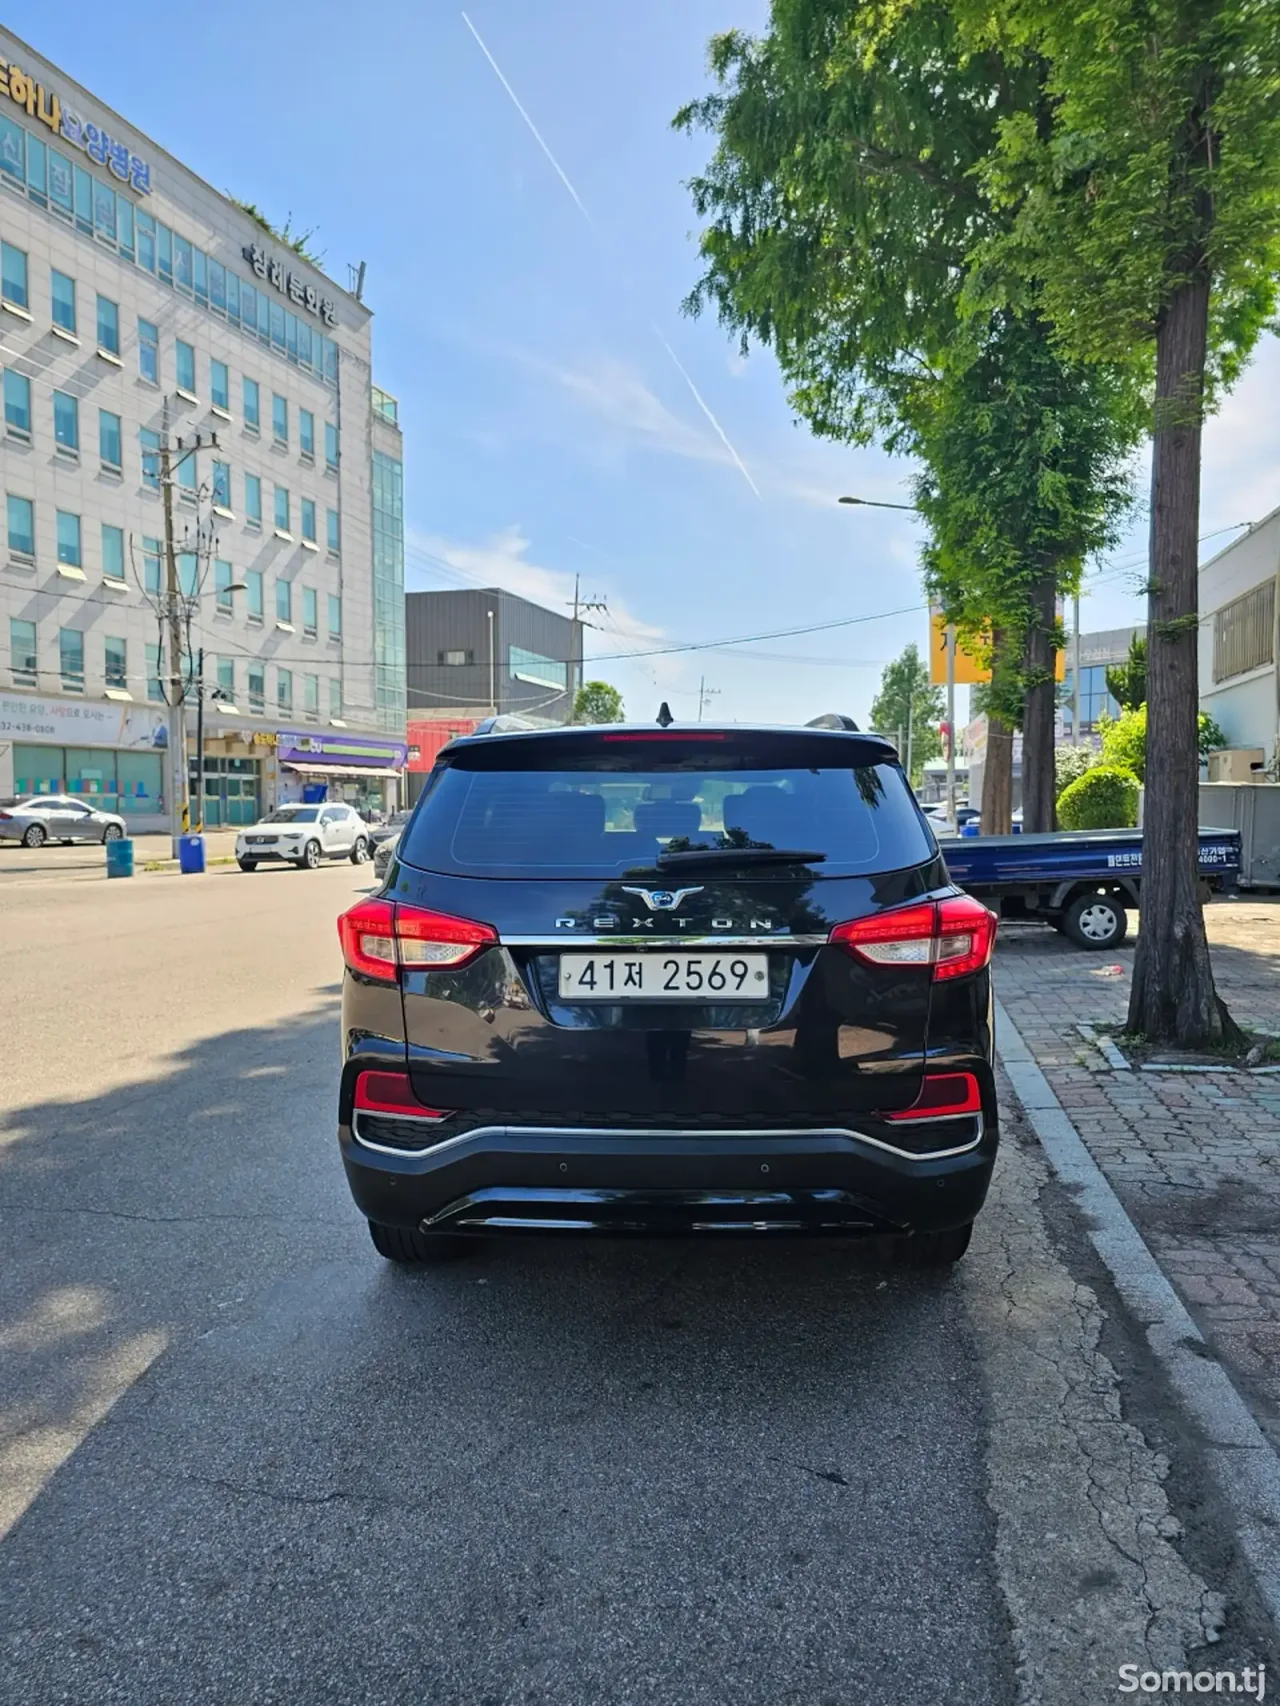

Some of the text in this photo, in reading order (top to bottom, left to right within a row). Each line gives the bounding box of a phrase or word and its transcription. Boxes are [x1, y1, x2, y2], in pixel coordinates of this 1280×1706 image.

[555, 917, 772, 928] REXTON
[577, 959, 749, 991] 41저 2569
